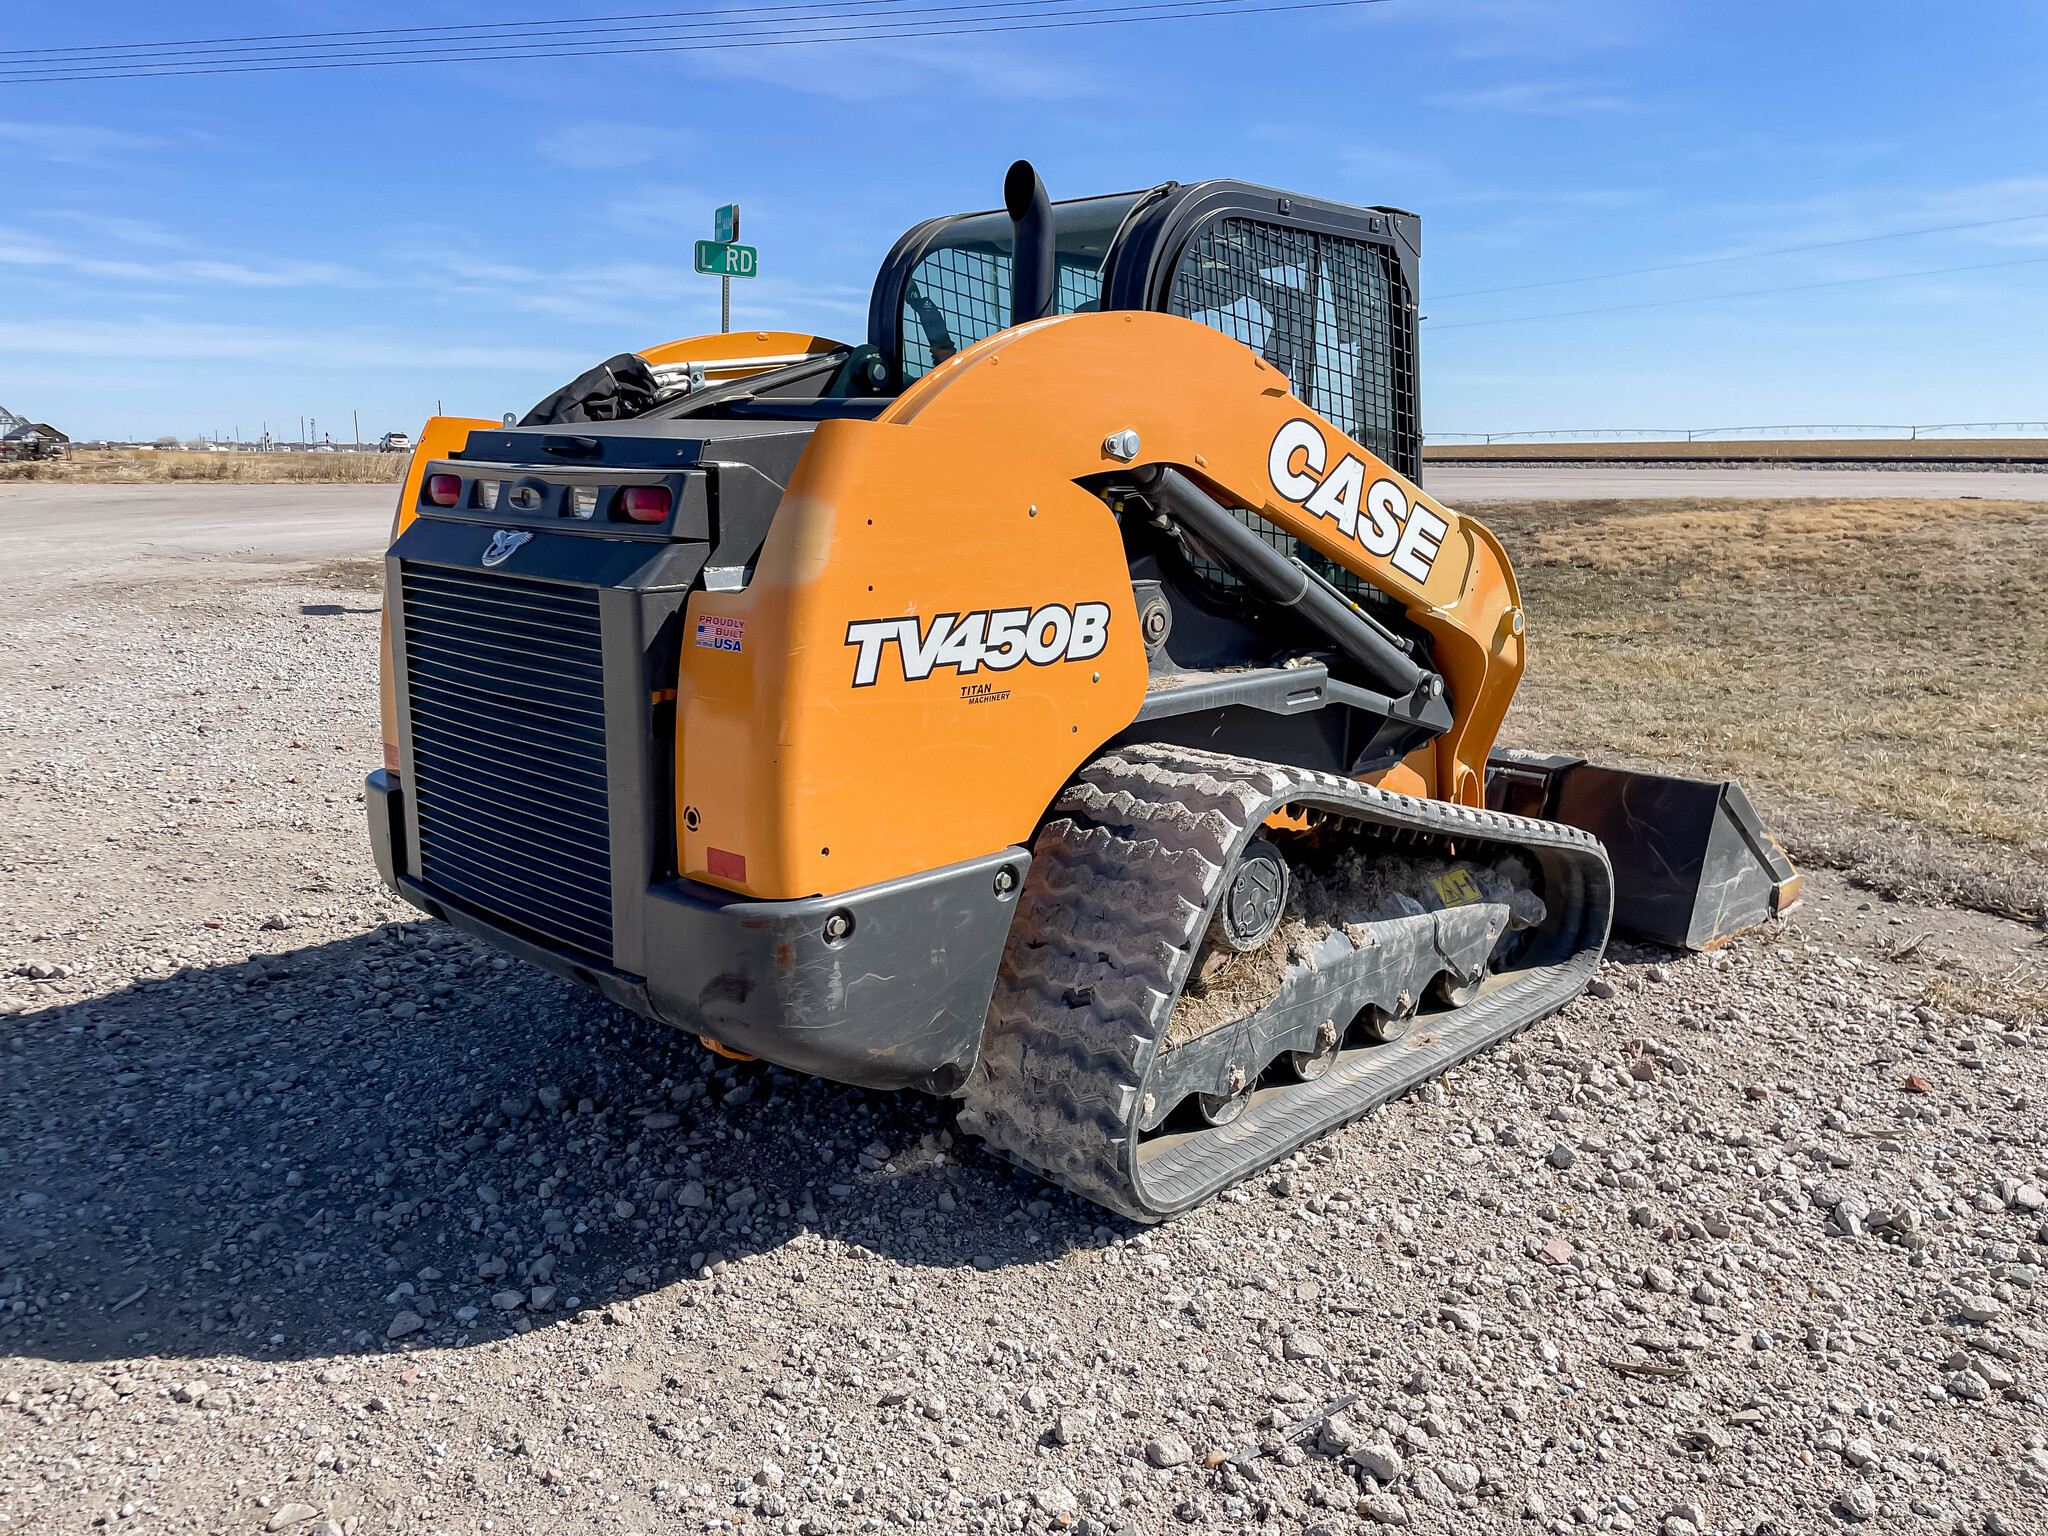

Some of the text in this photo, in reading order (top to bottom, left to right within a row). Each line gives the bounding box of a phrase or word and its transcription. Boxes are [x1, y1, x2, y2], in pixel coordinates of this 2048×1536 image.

[701, 245, 752, 273] L RD
[1268, 417, 1449, 586] CASE
[699, 615, 745, 628] PROUDLY
[715, 627, 744, 638] BUILT
[714, 637, 741, 652] USA
[844, 601, 1111, 688] TV450B
[961, 683, 992, 696] TITAN
[968, 692, 1010, 704] MACHINERY
